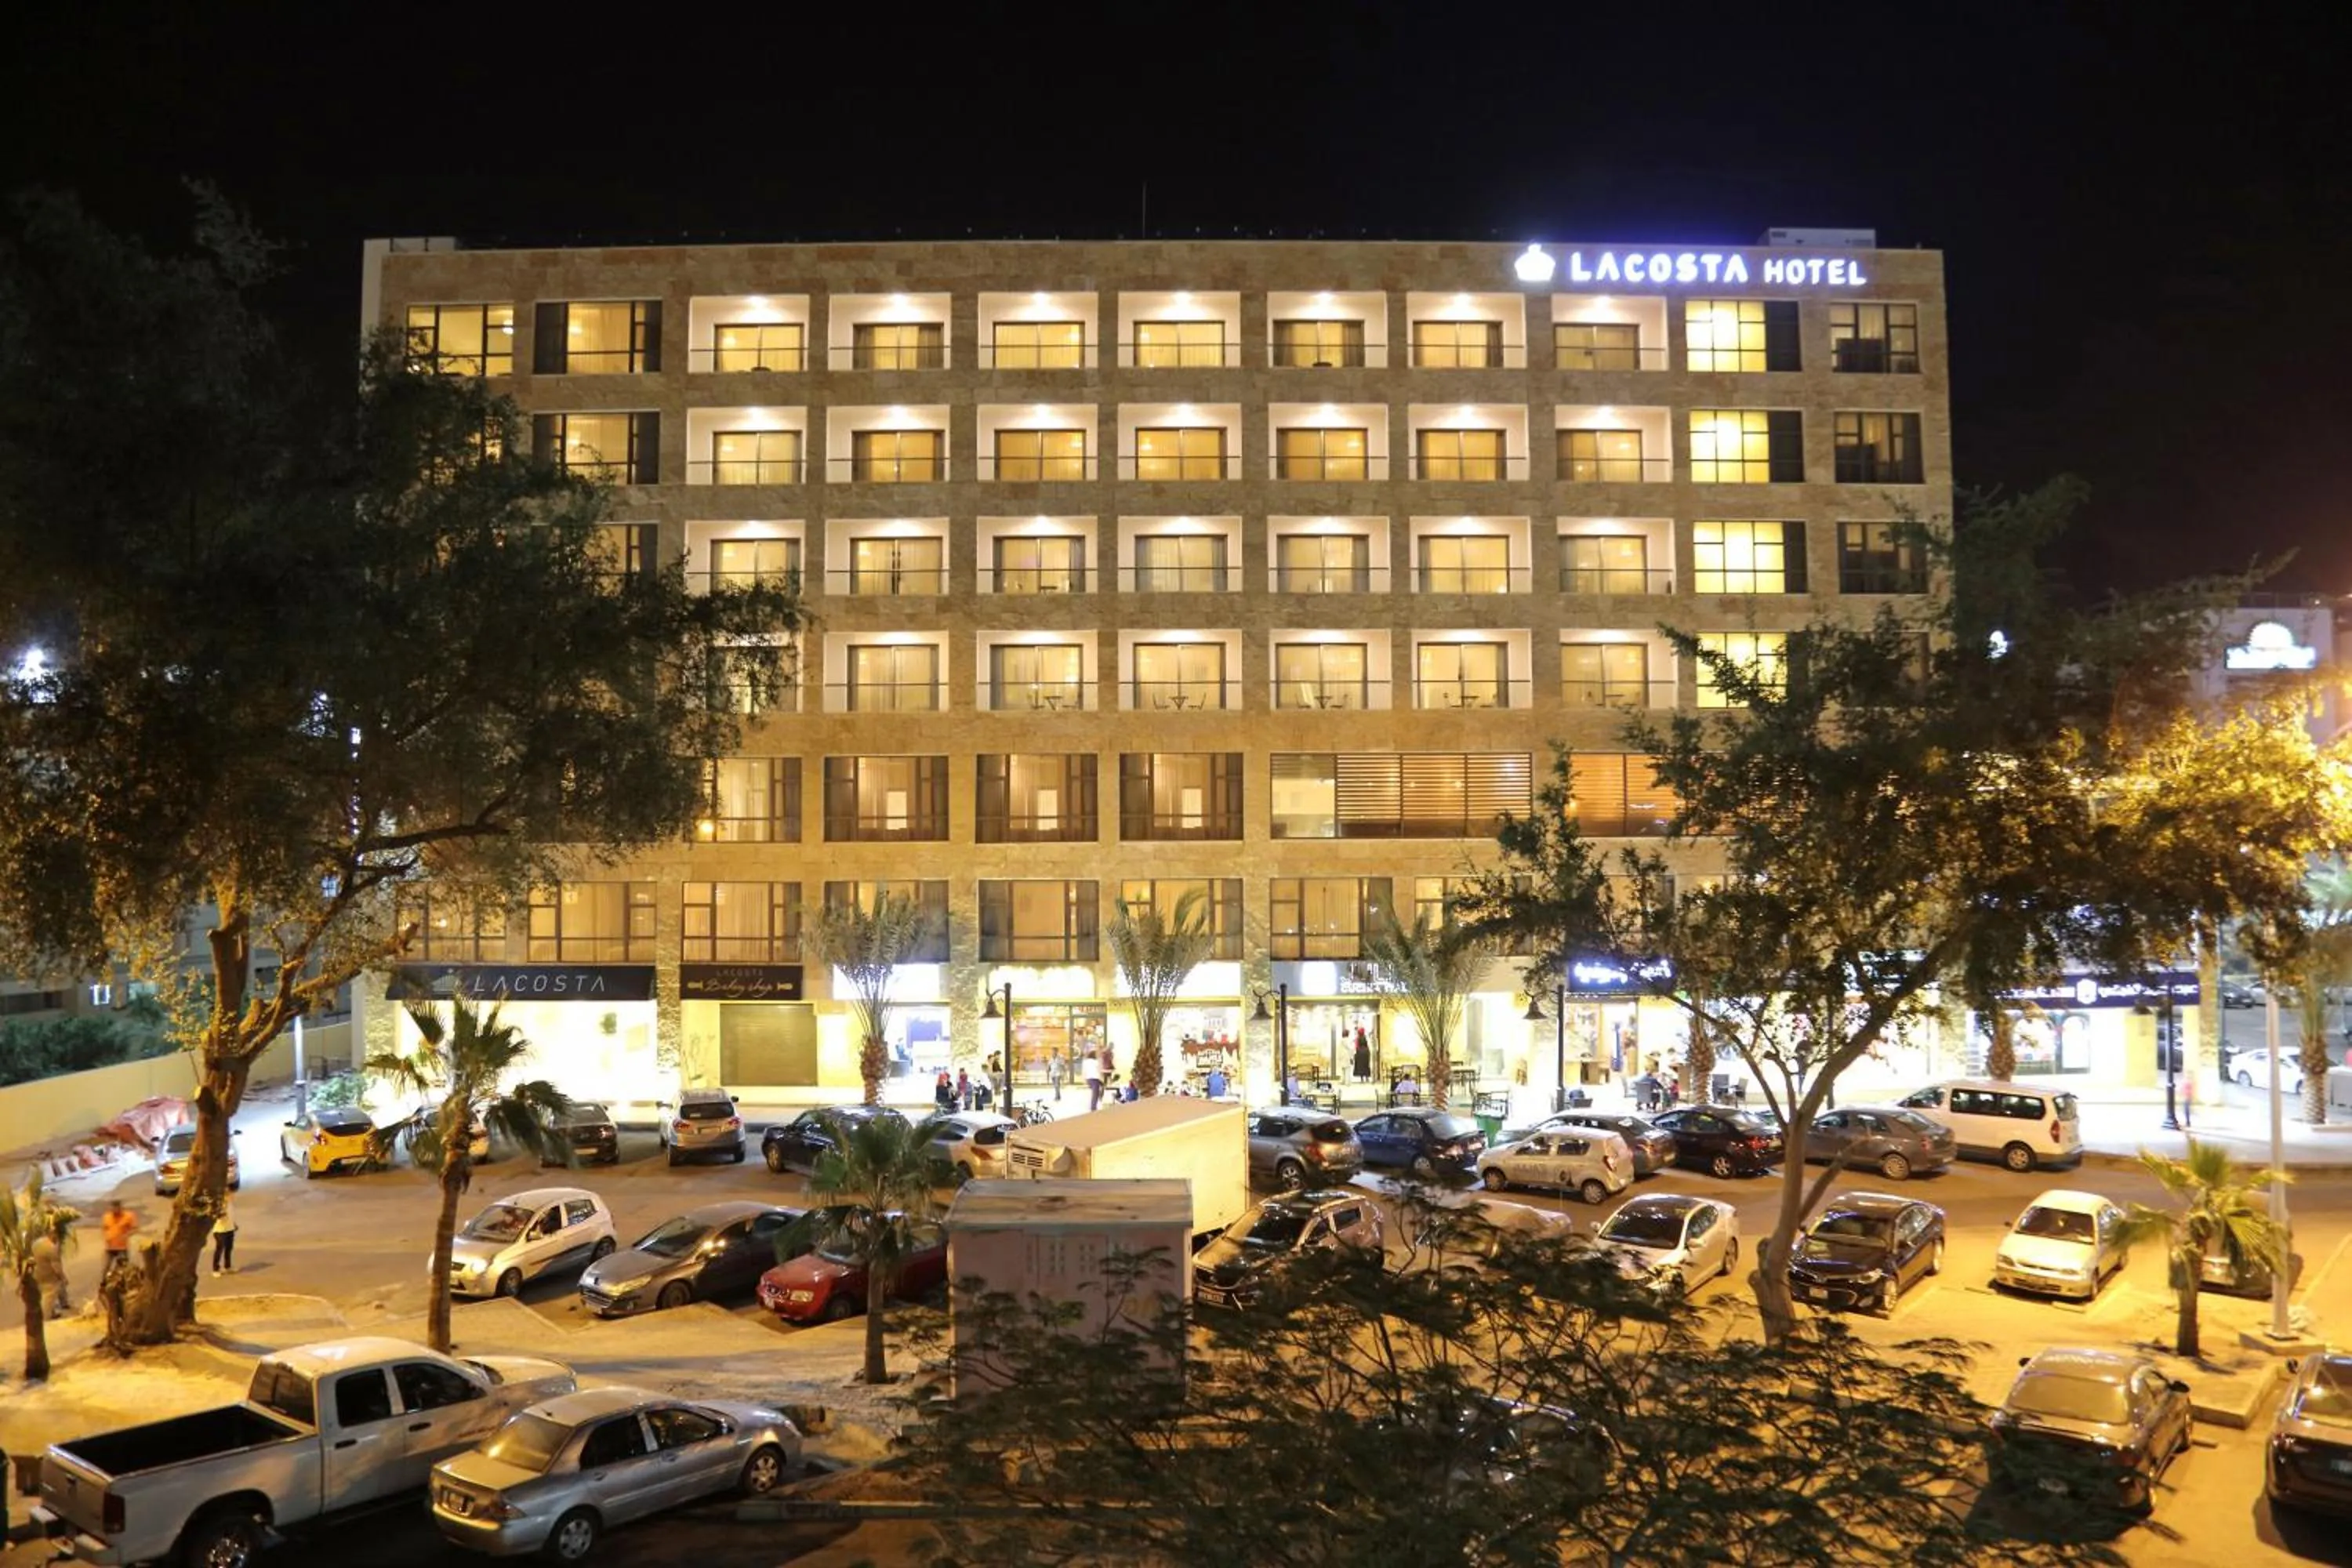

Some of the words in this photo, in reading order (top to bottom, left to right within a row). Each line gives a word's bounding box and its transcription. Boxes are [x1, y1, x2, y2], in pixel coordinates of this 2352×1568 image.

[1570, 252, 1748, 283] LACOSTA
[1764, 259, 1867, 286] HOTEL
[474, 975, 605, 992] LACOSTA
